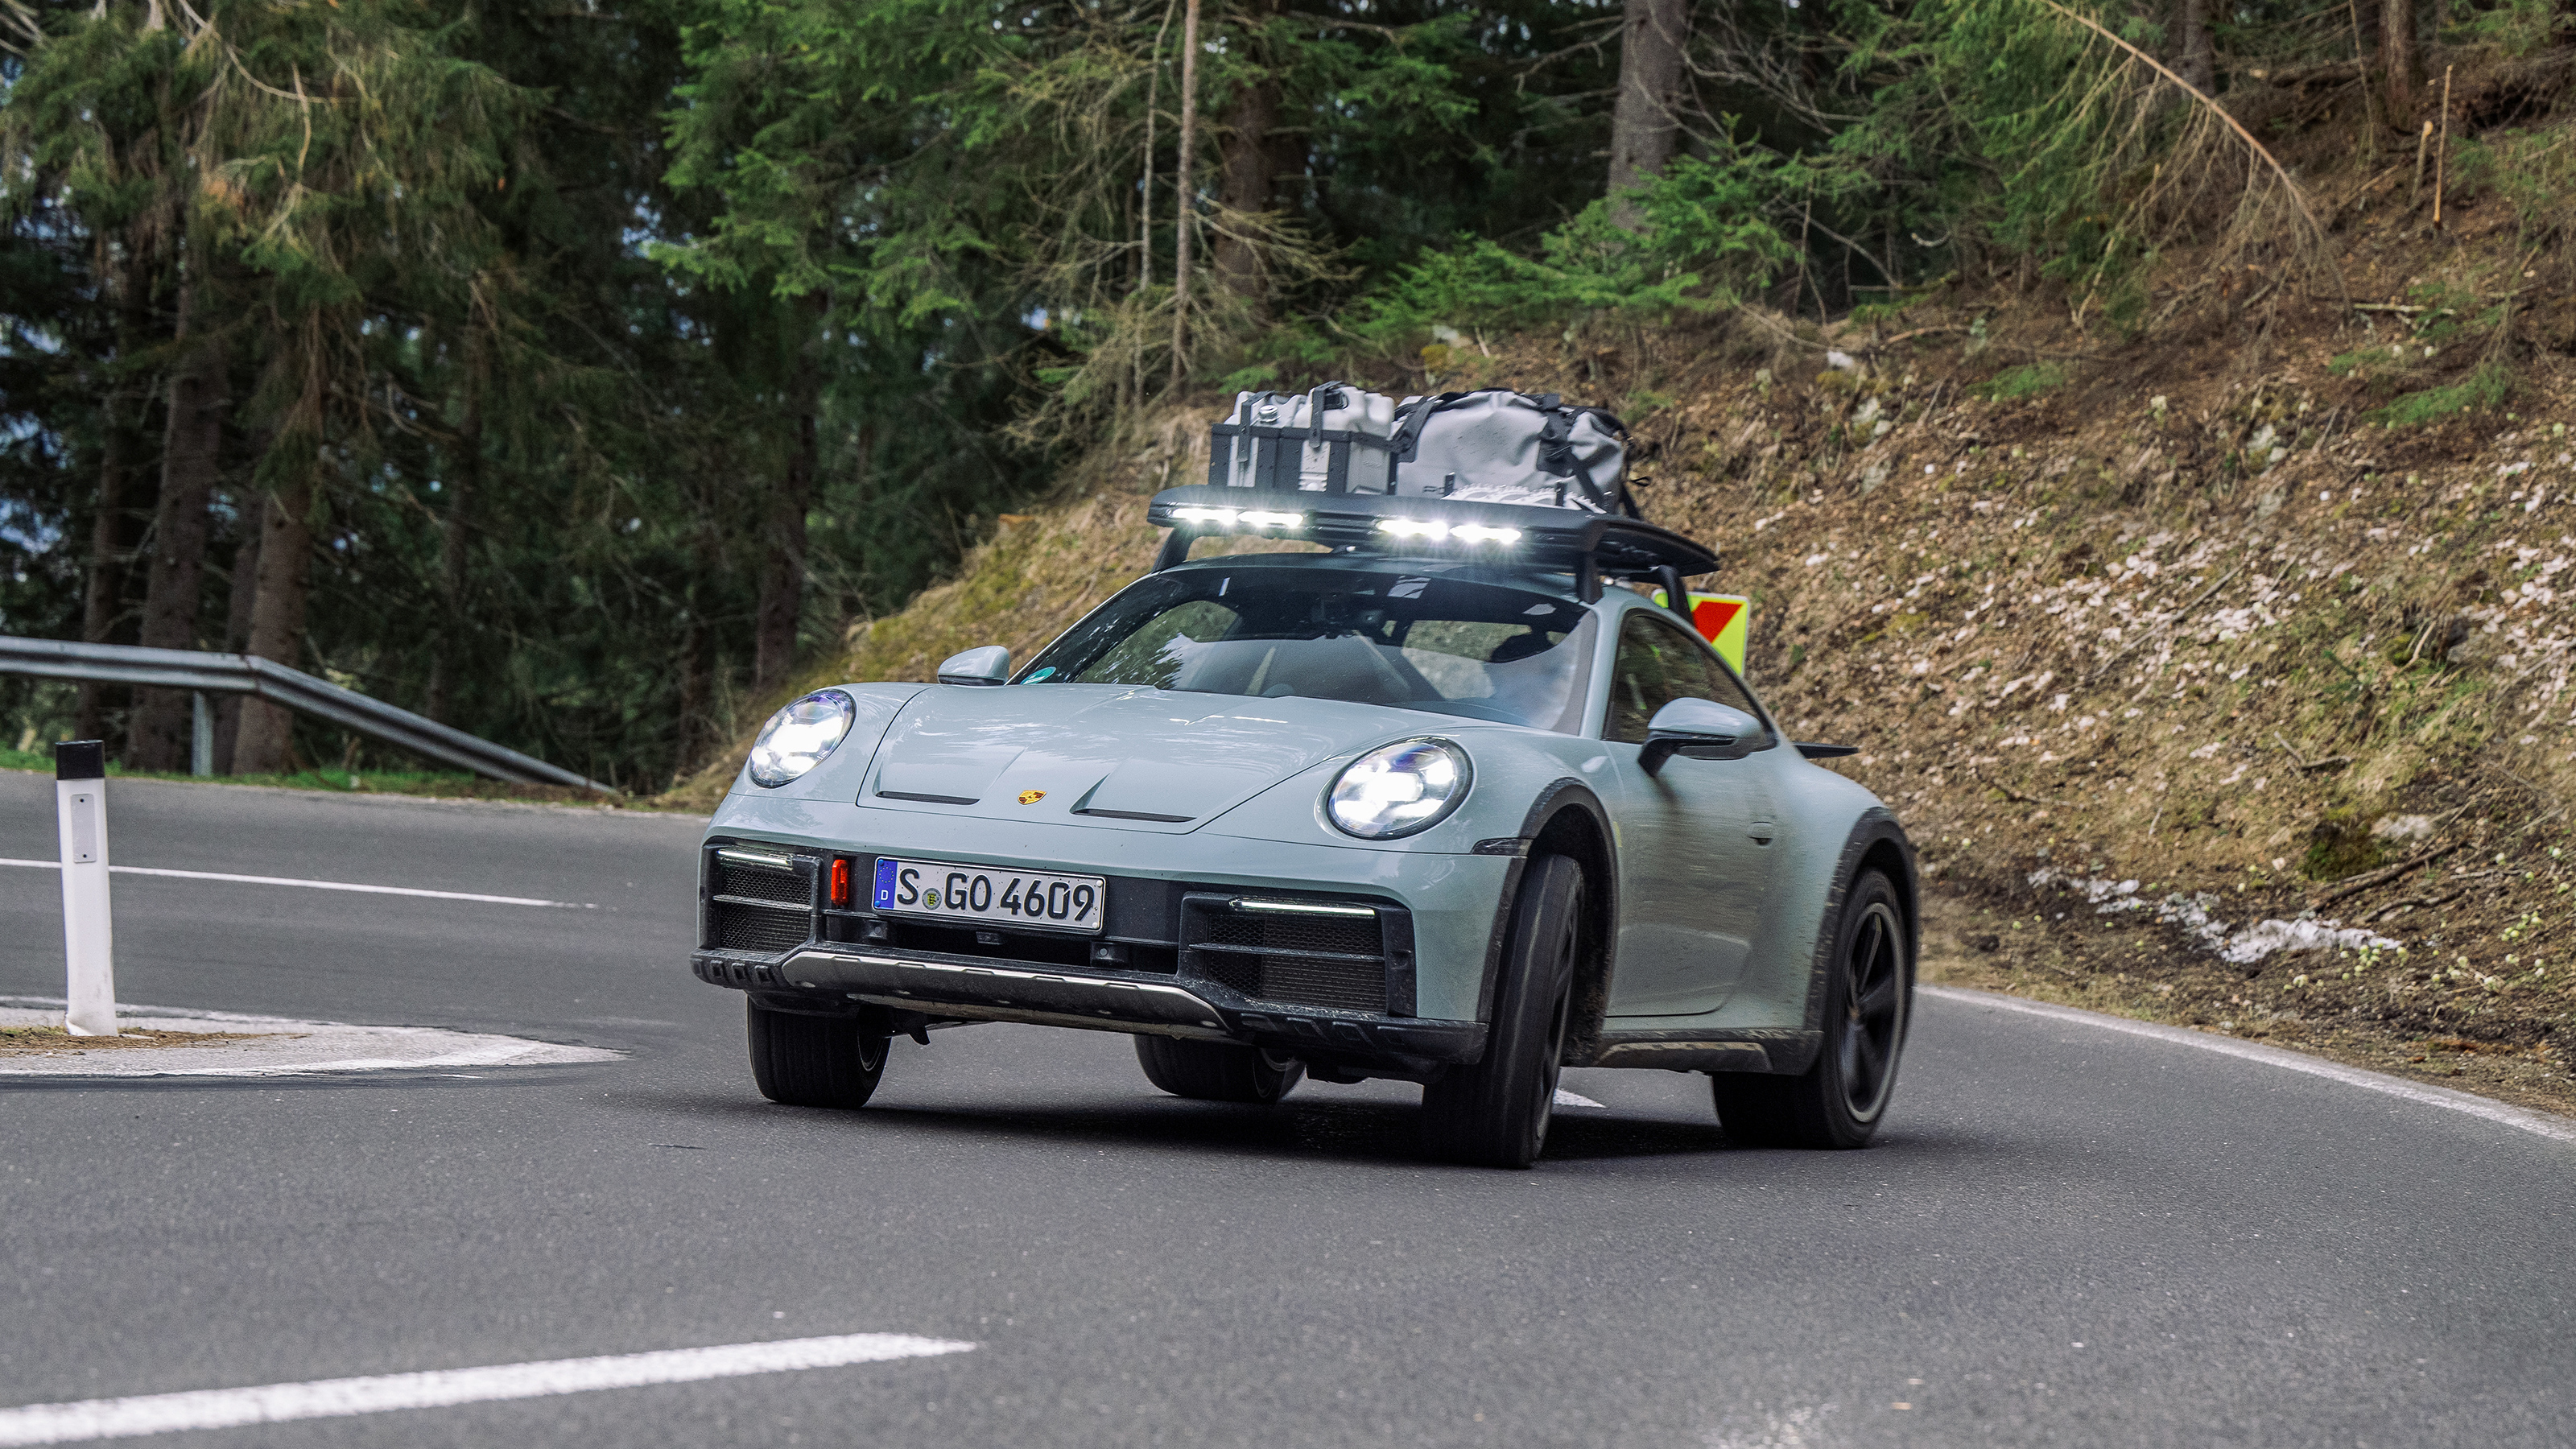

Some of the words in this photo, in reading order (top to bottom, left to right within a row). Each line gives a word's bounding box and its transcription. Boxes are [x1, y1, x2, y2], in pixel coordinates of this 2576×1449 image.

[881, 890, 888, 900] D
[897, 868, 919, 905] S
[944, 872, 991, 911] GO
[1000, 877, 1095, 921] 4609
